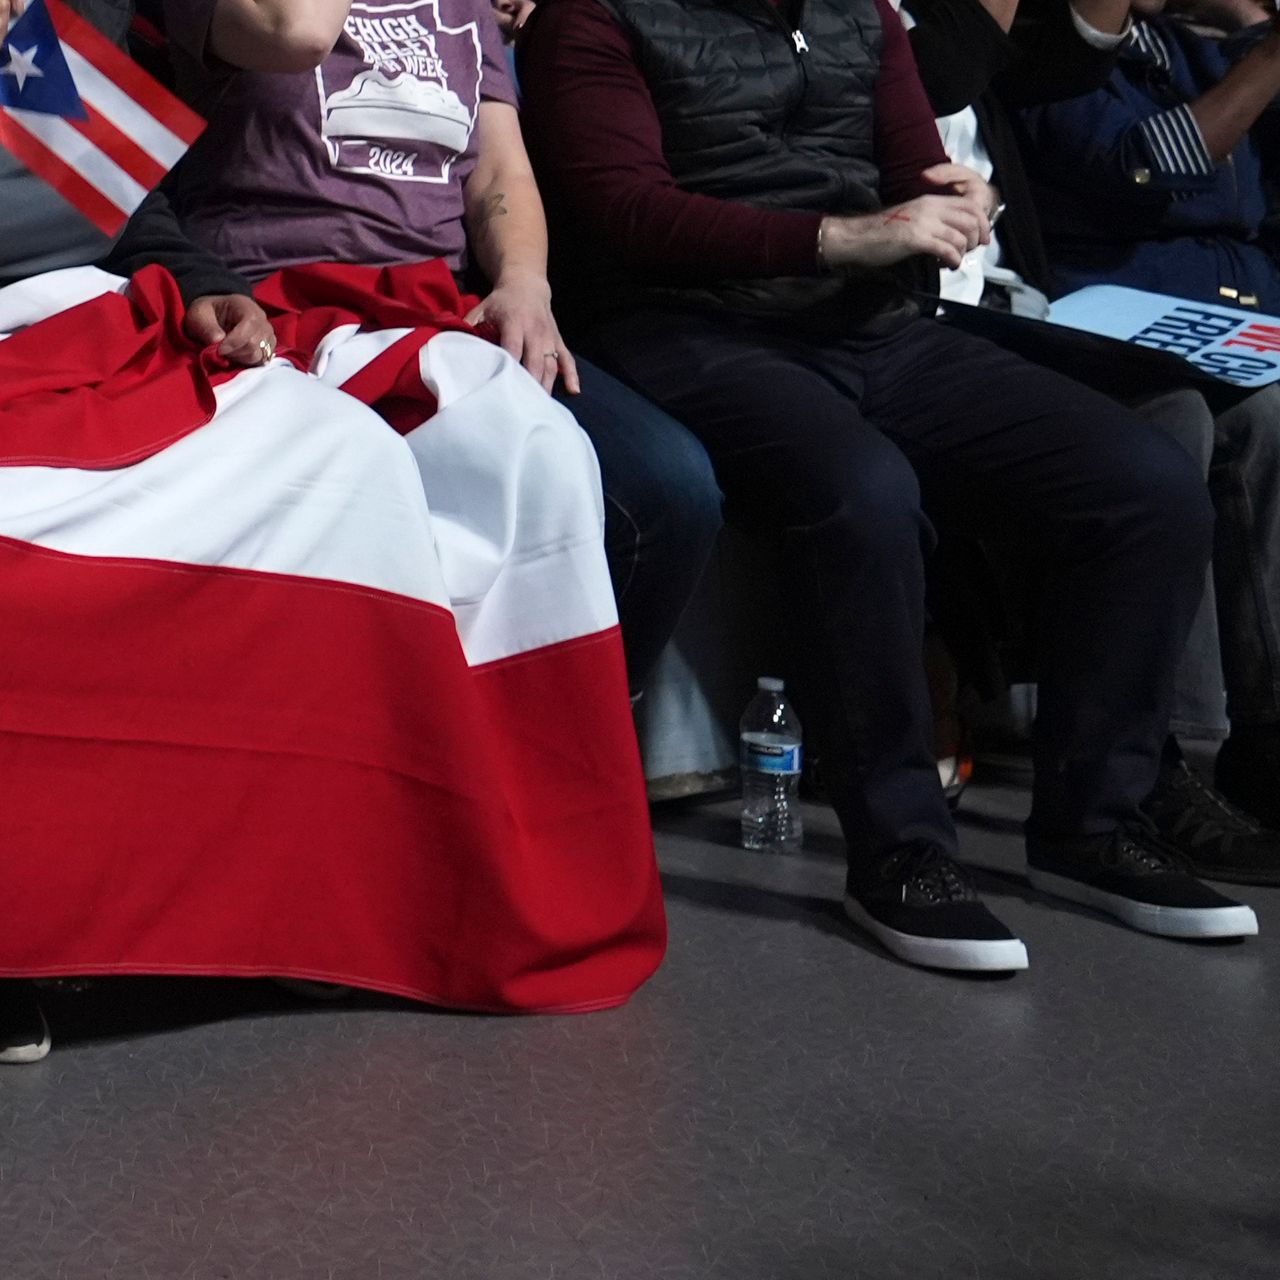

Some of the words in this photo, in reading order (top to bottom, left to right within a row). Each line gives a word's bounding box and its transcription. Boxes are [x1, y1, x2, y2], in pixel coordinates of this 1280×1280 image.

[344, 15, 429, 43] EHIGH
[360, 34, 439, 63] ALLEY
[401, 55, 449, 78] WEEK
[368, 147, 418, 176] 2024
